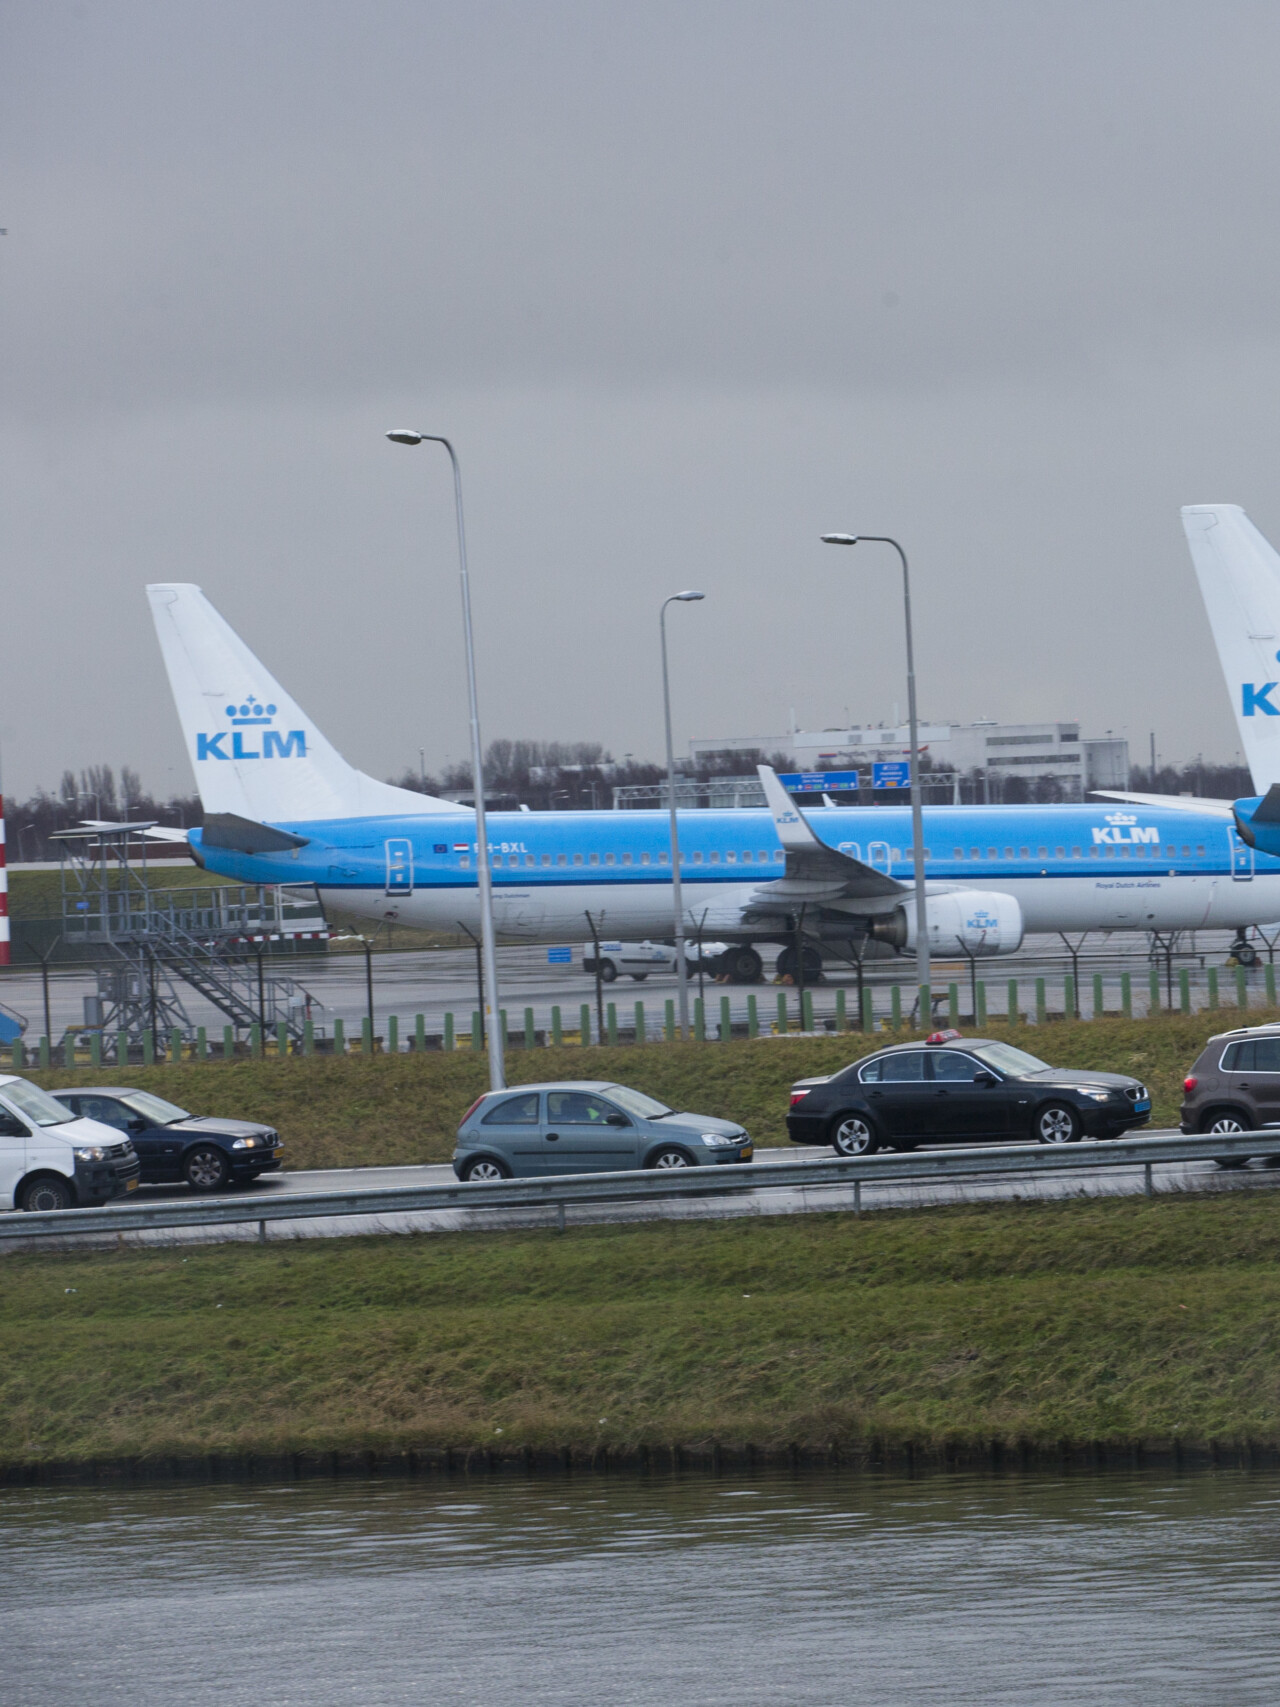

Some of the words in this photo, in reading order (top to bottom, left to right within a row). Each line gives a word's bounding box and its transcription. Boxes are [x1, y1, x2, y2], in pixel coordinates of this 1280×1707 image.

[196, 730, 307, 760] KLM
[1091, 827, 1160, 844] KLM
[966, 919, 998, 928] KLM
